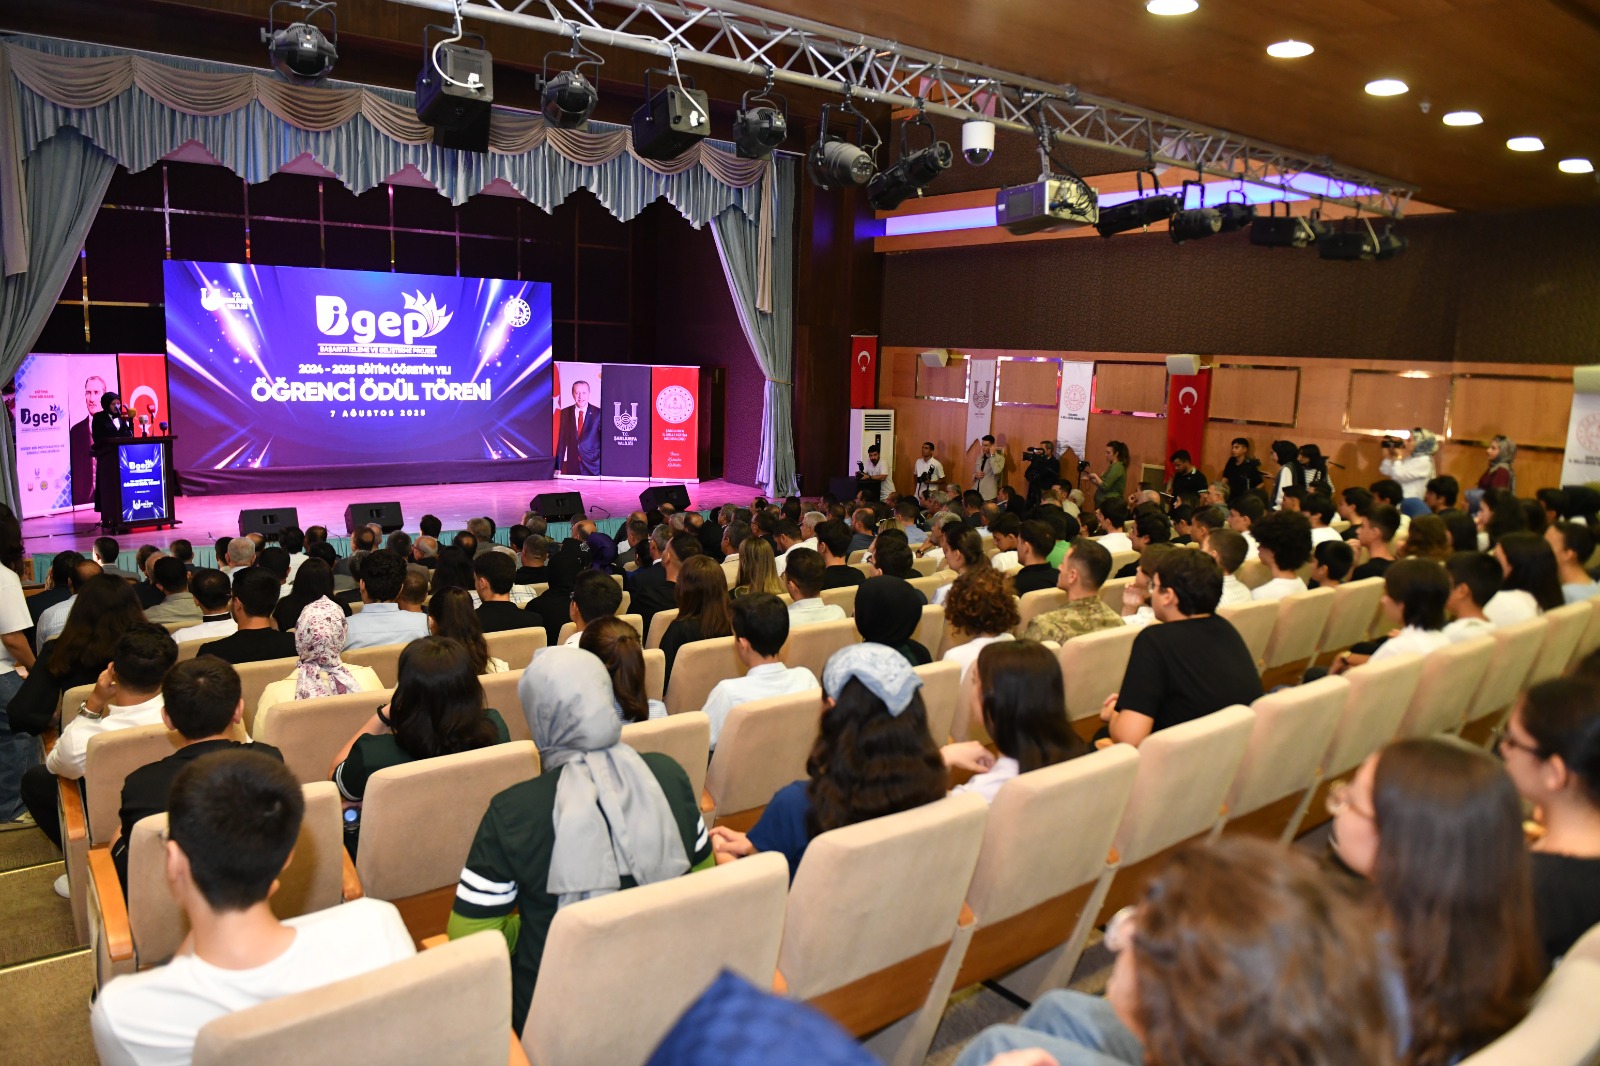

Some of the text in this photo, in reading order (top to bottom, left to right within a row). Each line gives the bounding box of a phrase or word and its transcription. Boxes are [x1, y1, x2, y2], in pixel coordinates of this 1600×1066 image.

[298, 364, 324, 374] 2024
[332, 364, 356, 374] 2025
[357, 362, 390, 375] EĞİTİM
[391, 363, 434, 375] ÖĞRETİM
[435, 365, 452, 375] YILI
[251, 376, 492, 402] ÖĞRENCİ ÖDÜL TÖRENİ
[342, 409, 394, 418] AĞUSTOS
